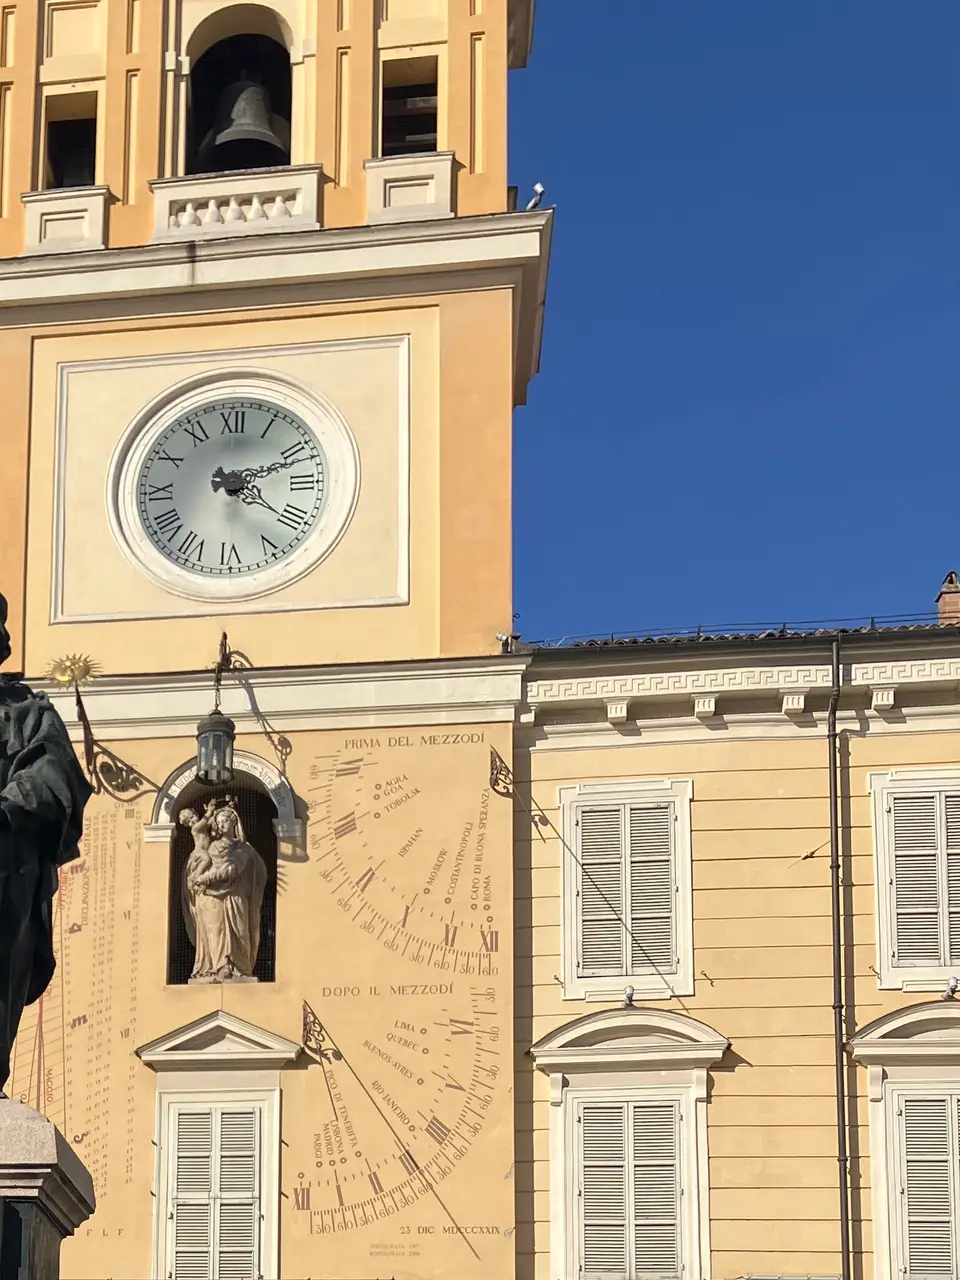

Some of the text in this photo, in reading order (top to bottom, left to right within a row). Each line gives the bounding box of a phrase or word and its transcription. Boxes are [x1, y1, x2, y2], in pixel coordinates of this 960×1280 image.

[183, 420, 210, 447] XI
[220, 411, 245, 435] XII
[260, 418, 276, 439] I
[158, 450, 184, 468] X
[280, 441, 305, 460] II
[149, 483, 173, 502] IX
[290, 474, 314, 491] III
[154, 508, 183, 542] VIII
[277, 503, 308, 531] IIII
[177, 531, 205, 562] VII
[220, 542, 242, 565] VI
[260, 535, 278, 555] V
[344, 738, 381, 750] PRIMA
[388, 737, 414, 748] DEL
[383, 785, 403, 796] GOA
[385, 774, 408, 788] AGRA
[384, 787, 421, 812] TOBOLSK
[398, 827, 424, 858] ISPAHAN
[471, 788, 490, 900] CAPO DI BUONA SPERANZA
[427, 848, 448, 886] MOSKOW
[447, 822, 473, 895] COSTANTINOPOLI
[440, 923, 458, 948] XI
[479, 930, 498, 953] XII
[322, 986, 360, 997] DOPO
[370, 986, 380, 996] IL
[394, 1020, 415, 1032] LIMA
[386, 1032, 419, 1051] QUEBEC
[326, 1070, 338, 1090] PICO
[333, 1093, 343, 1103] DI
[314, 1133, 322, 1159] PARIGI
[323, 1123, 334, 1155] MADRID
[330, 1120, 344, 1155] LISBONA
[292, 1187, 311, 1210] XII
[443, 1226, 500, 1235] MDCCCXXIX
